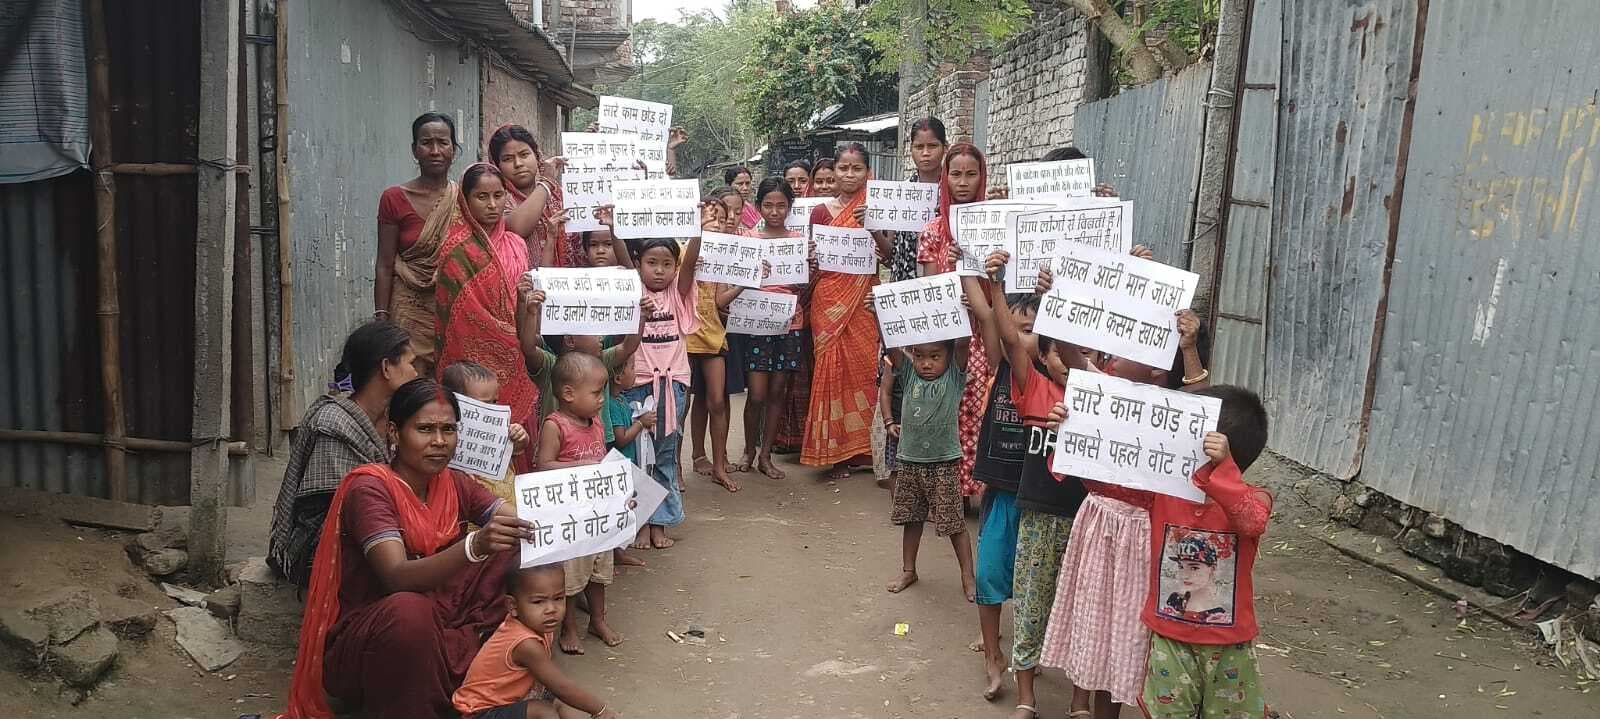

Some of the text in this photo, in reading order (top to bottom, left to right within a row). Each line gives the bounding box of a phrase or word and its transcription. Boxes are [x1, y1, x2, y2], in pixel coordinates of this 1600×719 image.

[603, 103, 667, 127] सारे काम छोड़ दो
[566, 143, 594, 156] जन-जन
[609, 143, 628, 161] पुकार
[566, 182, 578, 195] घर
[582, 181, 594, 194] घर
[597, 176, 605, 192] में
[870, 187, 880, 198] घर
[883, 187, 893, 200] घर
[925, 186, 933, 201] दो
[568, 202, 587, 220] वोट
[616, 208, 628, 226] वोट
[632, 208, 653, 226] डालोगे
[656, 212, 673, 225] कसम
[676, 207, 695, 225] खाओ
[869, 205, 930, 222] वोट दो वोट दो
[1018, 221, 1037, 234] आप
[1040, 215, 1065, 233] लोगों
[1067, 214, 1075, 232] से
[703, 241, 728, 254] जन-जन
[729, 241, 739, 256] की
[741, 245, 757, 262] पुकार
[797, 240, 804, 254] दो
[841, 232, 851, 246] की
[852, 237, 868, 251] पुकार
[713, 260, 724, 274] देना
[726, 262, 752, 278] अधिकार
[753, 265, 759, 280] है
[776, 260, 804, 275] वोट दो
[827, 252, 838, 265] देना
[841, 253, 865, 268] अधिकार
[878, 279, 957, 310] सारे काम छोड़ दो
[1094, 261, 1125, 291] आंटी
[1126, 273, 1152, 300] मान
[1152, 279, 1186, 309] जाओ
[546, 300, 560, 321] वोट
[563, 300, 588, 322] डालोगे
[590, 305, 611, 322] कसम
[614, 300, 635, 321] खाओ
[760, 297, 768, 310] की
[770, 301, 788, 317] पुकार
[884, 306, 962, 336] सबसे पहले वोट दो
[1045, 289, 1173, 350] वोट डालोगे कसम खाओ
[1072, 383, 1209, 440] सारे काम छोड़ दो
[1064, 429, 1200, 482] सबसे पहले वोट दो
[521, 465, 628, 508] घर घर में संदेश दो
[561, 514, 578, 544] दो
[584, 510, 609, 537] वोट
